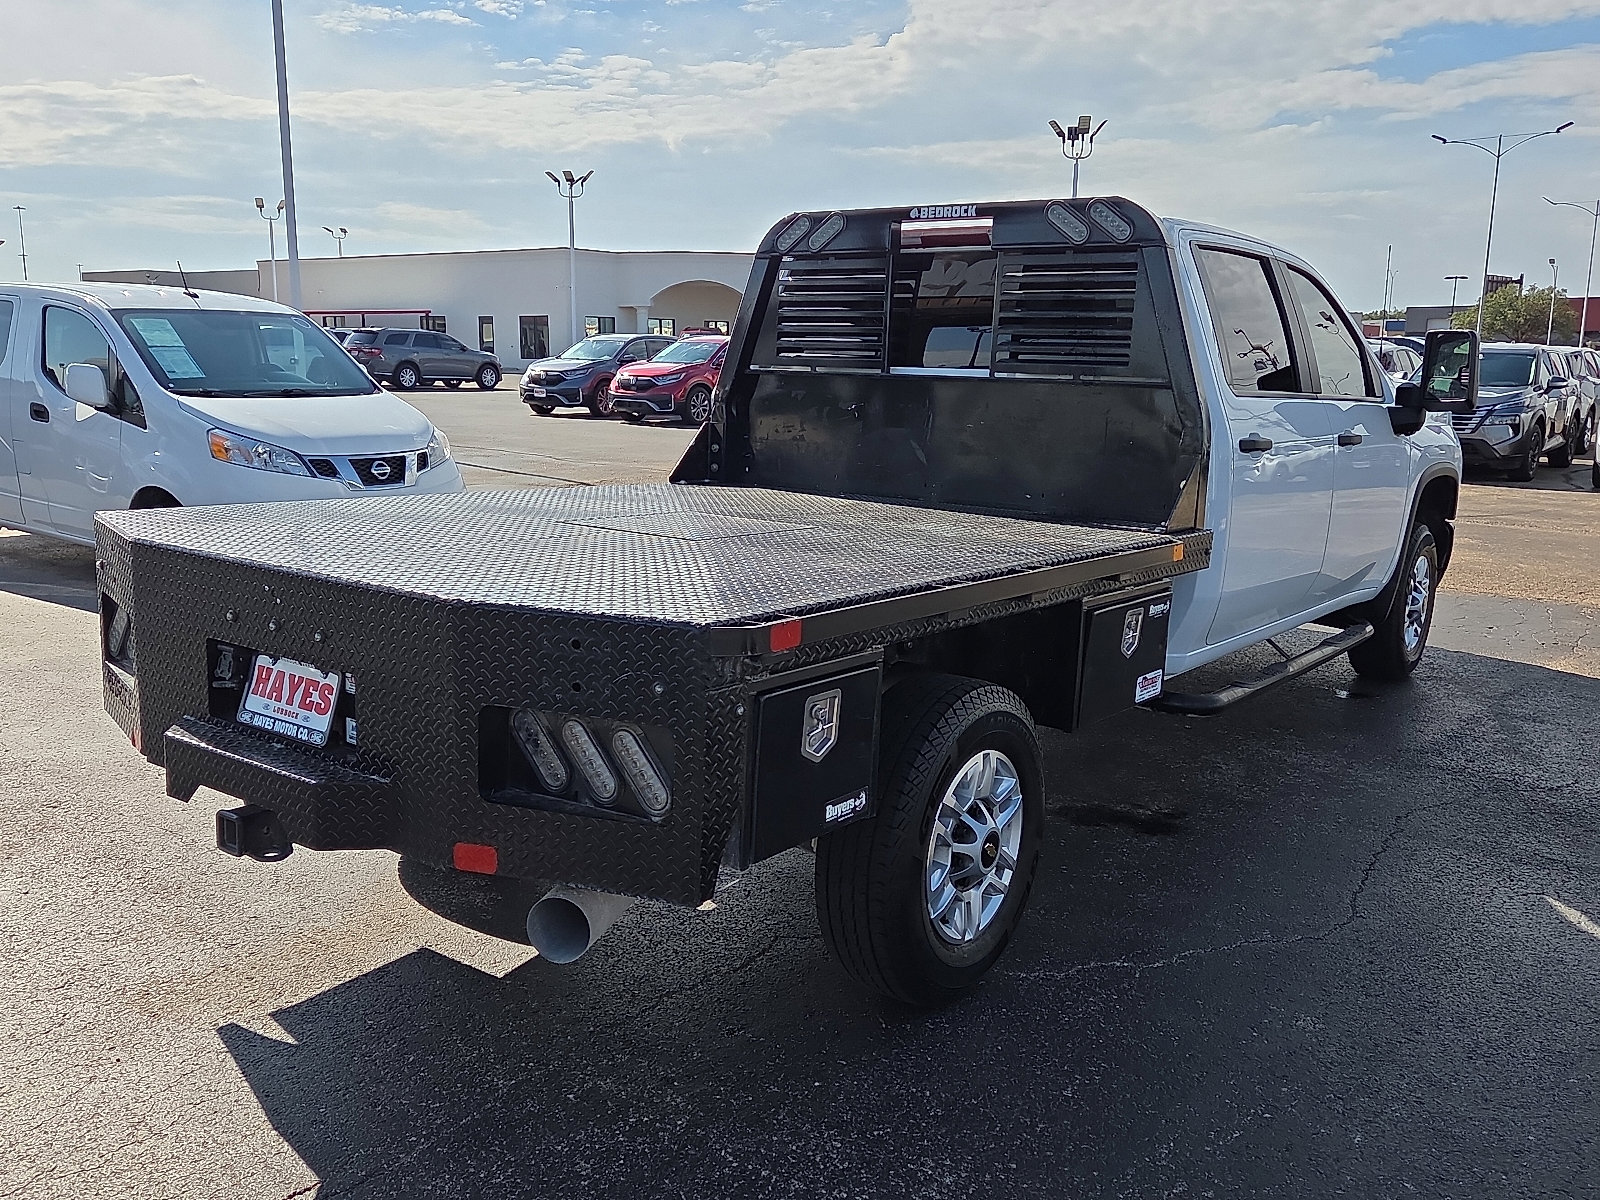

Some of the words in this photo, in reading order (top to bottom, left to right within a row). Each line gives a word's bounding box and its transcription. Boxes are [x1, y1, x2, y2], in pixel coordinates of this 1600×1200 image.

[920, 205, 977, 219] BEDROCK
[251, 664, 335, 716] HAYES
[252, 714, 275, 730] HAYES
[273, 720, 298, 737] MOTOR
[297, 728, 309, 741] CO.
[825, 798, 855, 819] Buyers
